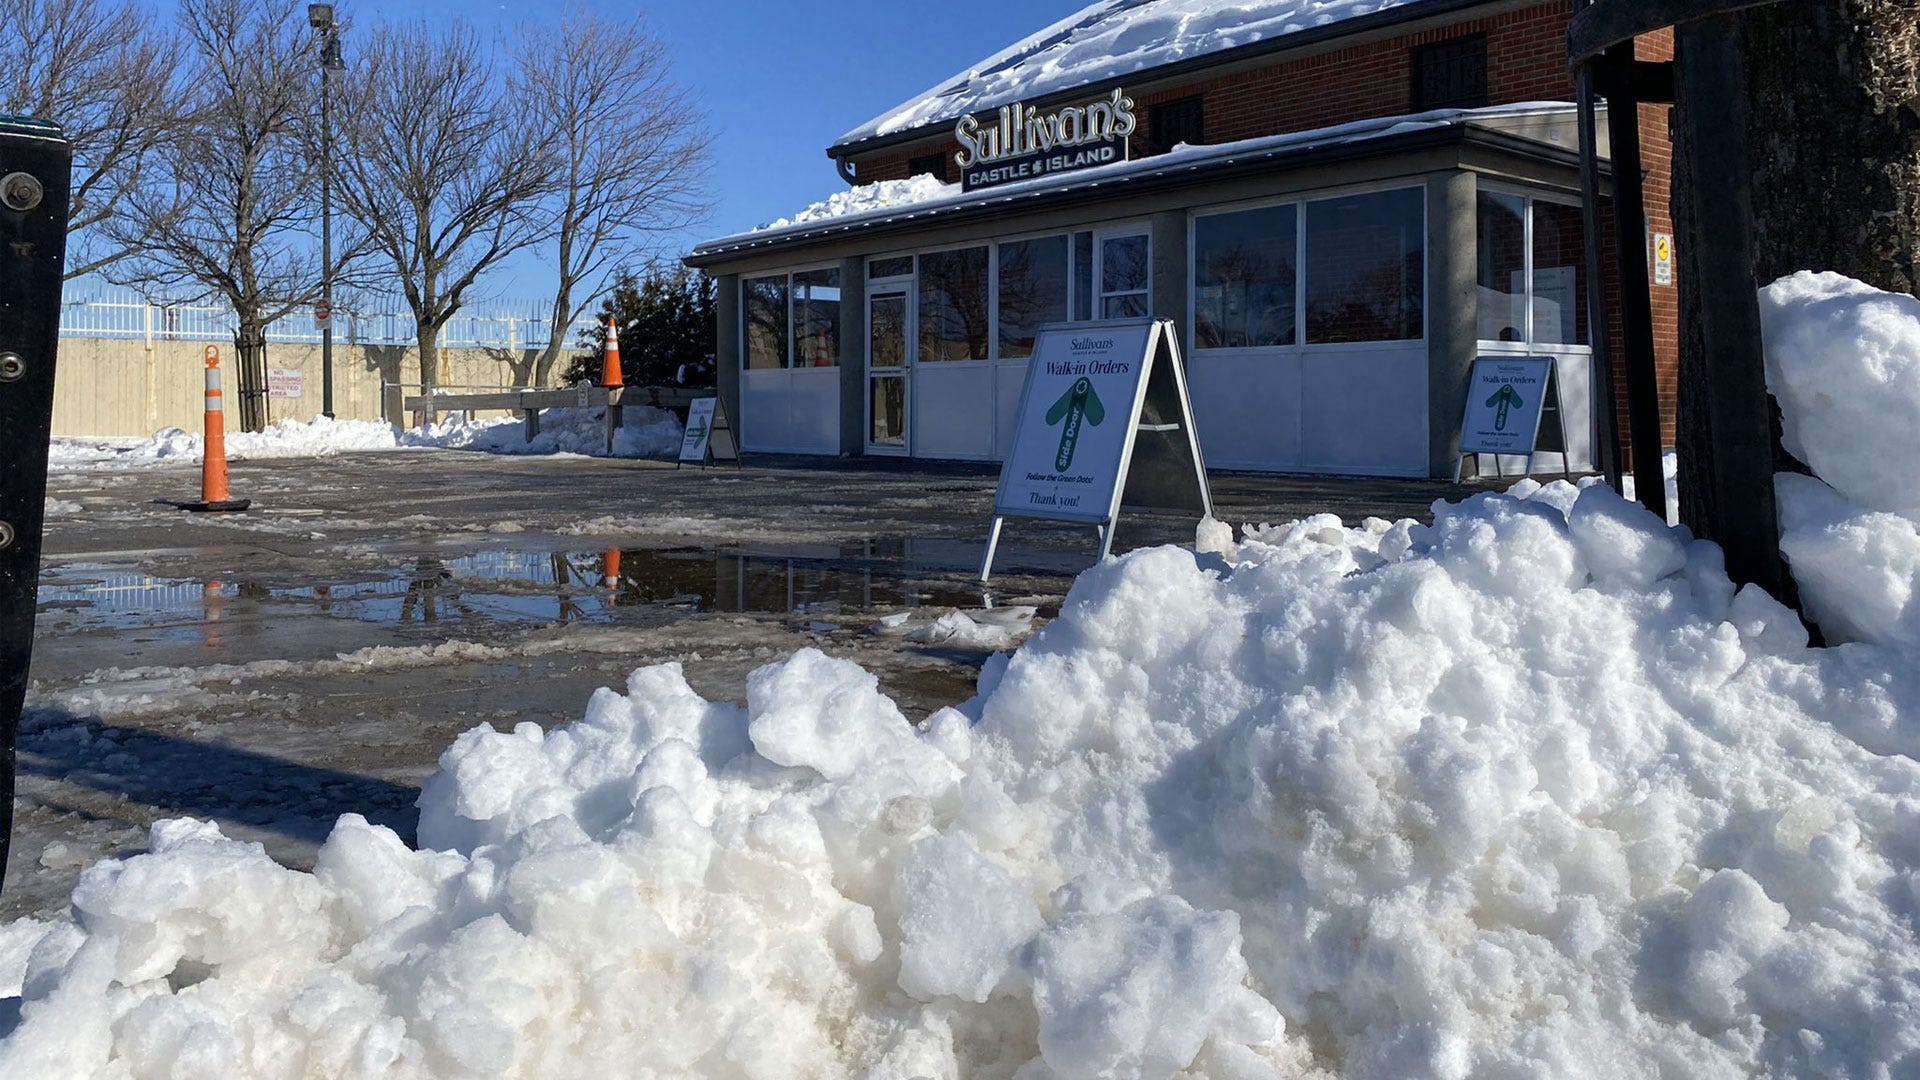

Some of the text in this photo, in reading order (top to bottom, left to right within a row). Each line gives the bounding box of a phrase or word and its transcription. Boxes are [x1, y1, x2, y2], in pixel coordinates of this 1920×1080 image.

[954, 87, 1136, 169] Sullivan's
[969, 146, 1116, 187] CASTLE ISLAND
[1070, 337, 1114, 351] Sullivan's
[1046, 359, 1130, 376] Walk-in Orders
[1059, 406, 1081, 467] Side Door
[1025, 472, 1047, 481] Follow
[1046, 473, 1057, 482] the
[1029, 492, 1081, 509] Thank you!
